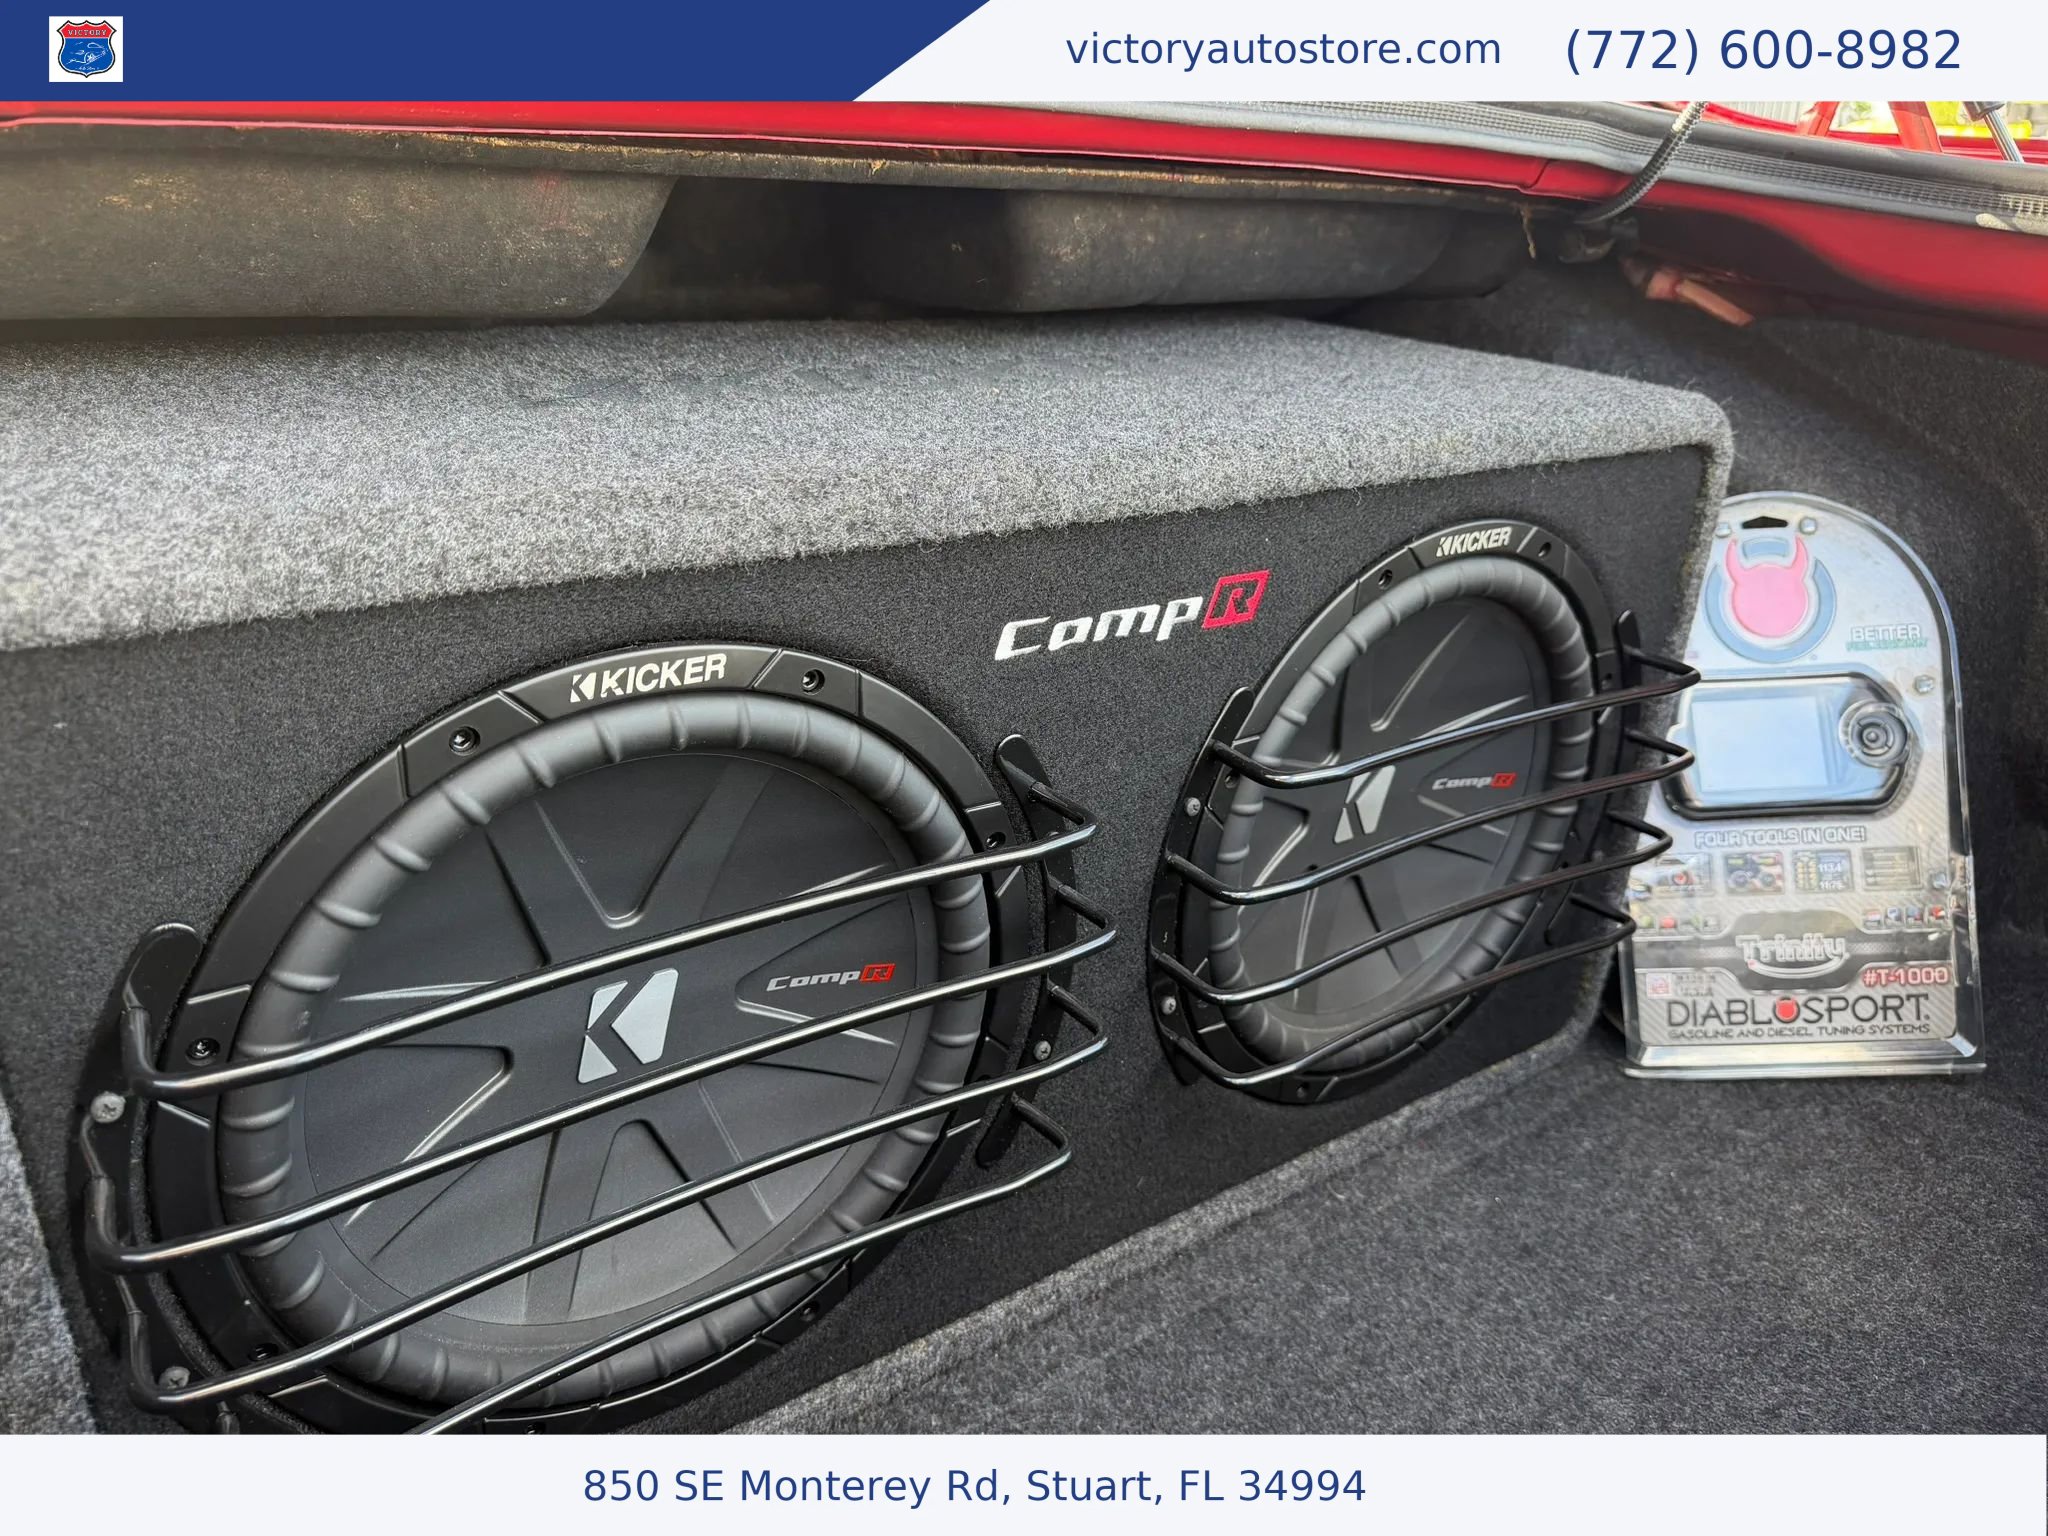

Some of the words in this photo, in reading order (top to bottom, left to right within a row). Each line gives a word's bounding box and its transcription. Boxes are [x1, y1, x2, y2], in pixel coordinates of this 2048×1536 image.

[1450, 526, 1512, 555] KICKER
[1850, 623, 1921, 642] BETTER
[600, 653, 727, 698] KICKER
[1694, 830, 1742, 848] FOUR
[1744, 827, 1800, 846] TOOLS
[1801, 828, 1822, 844] IN
[1824, 825, 1867, 843] ONE!
[1735, 933, 1850, 975] Trinity
[1862, 965, 1950, 988] #T-1000
[1736, 1028, 1764, 1038] AND
[1767, 1025, 1812, 1037] DIESEL
[1817, 1025, 1865, 1036] TUNING
[1868, 1023, 1930, 1035] SYSTEMS
